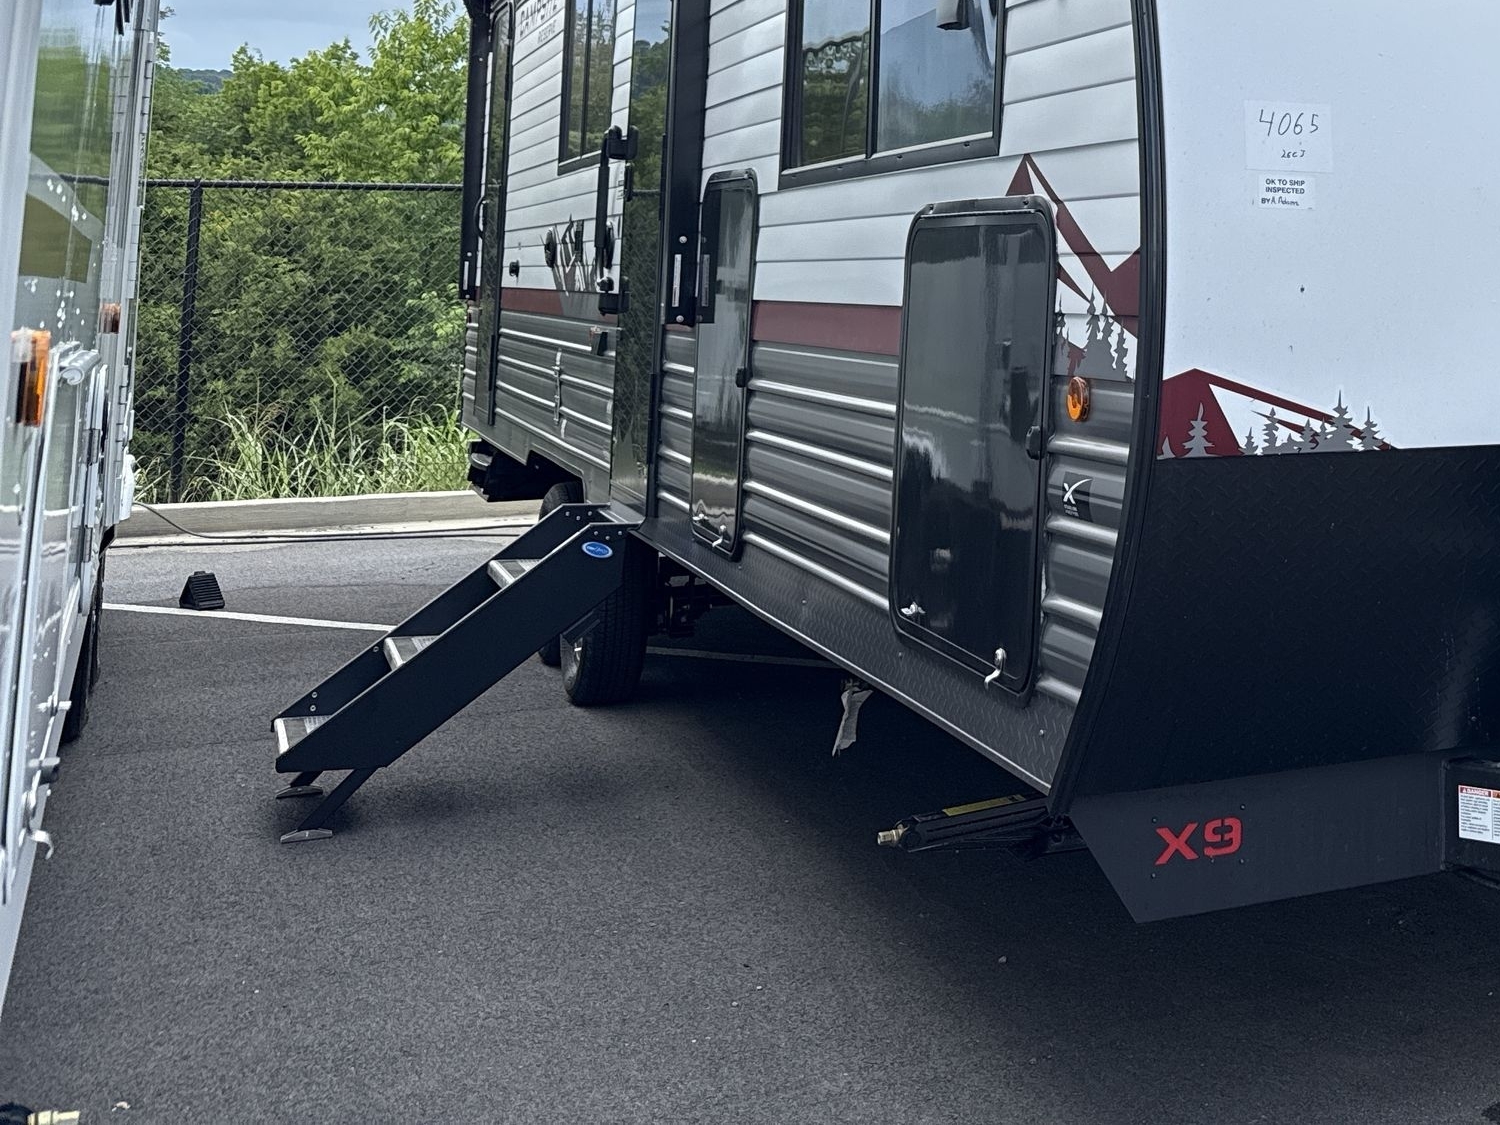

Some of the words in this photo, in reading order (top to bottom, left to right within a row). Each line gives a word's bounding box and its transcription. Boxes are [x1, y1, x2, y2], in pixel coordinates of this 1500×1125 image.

[1259, 109, 1319, 136] 4065
[1265, 178, 1276, 186] OK
[1289, 179, 1306, 187] SHIP
[1265, 186, 1305, 195] INSPECTED
[1155, 817, 1243, 866] X9
